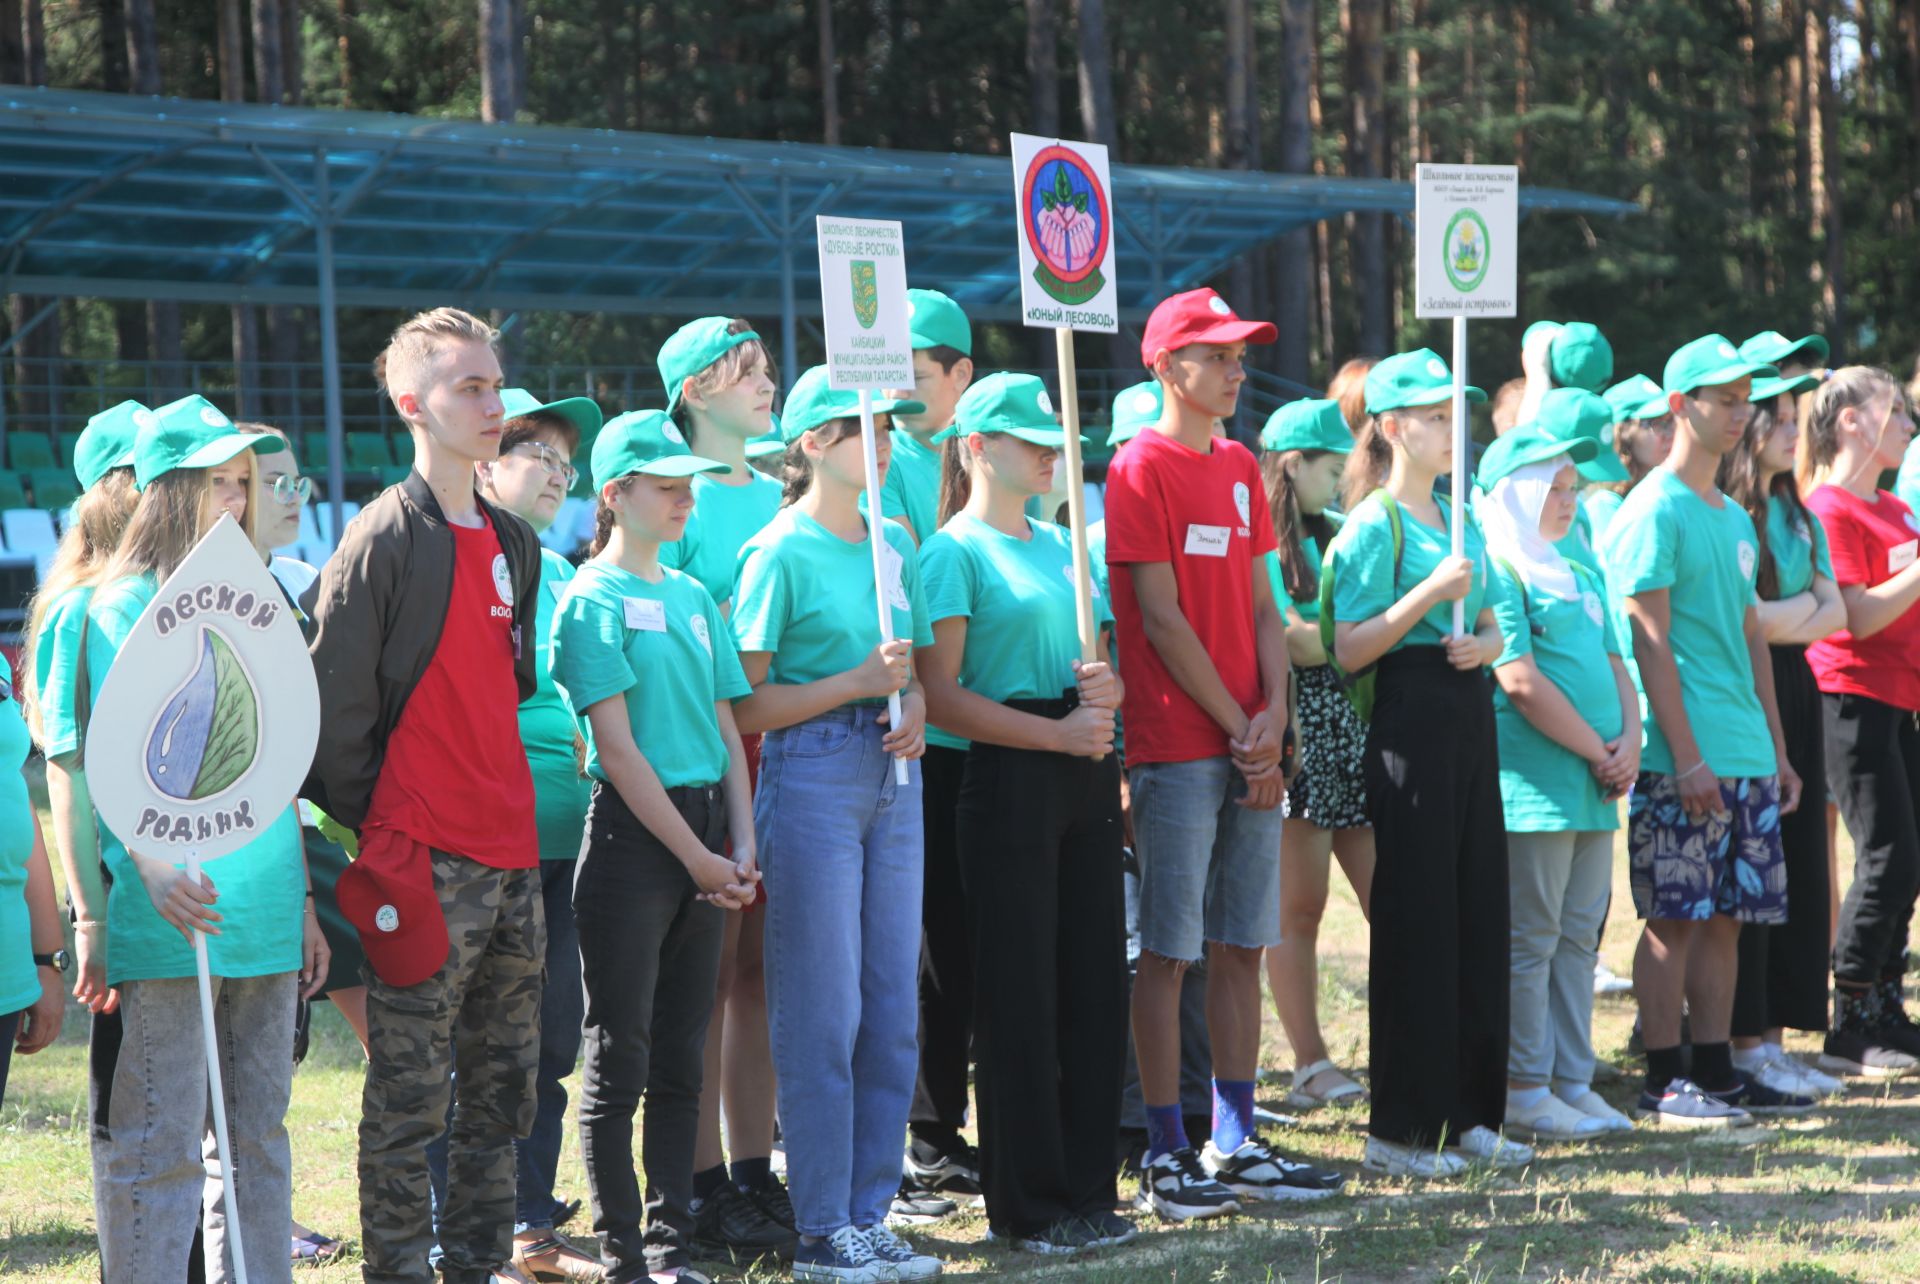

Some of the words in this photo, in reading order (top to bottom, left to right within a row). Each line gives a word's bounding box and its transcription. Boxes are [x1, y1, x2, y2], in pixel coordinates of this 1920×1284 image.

[822, 224, 854, 236] ШКОЛЬНОЕ
[855, 226, 899, 239] ЛЕСНИЧЕСТВО
[1027, 307, 1063, 322] «ЮНЫЙ
[1065, 310, 1115, 327] ЛЕСОВОД»
[833, 351, 885, 365] МУНИЦИПАЛЬНЫЙ
[886, 351, 908, 365] РАЙОН
[836, 370, 872, 383] РЕСПУБЛИКИ
[873, 370, 908, 382] ТАТАРСТАН
[136, 799, 255, 842] РОДНИК
